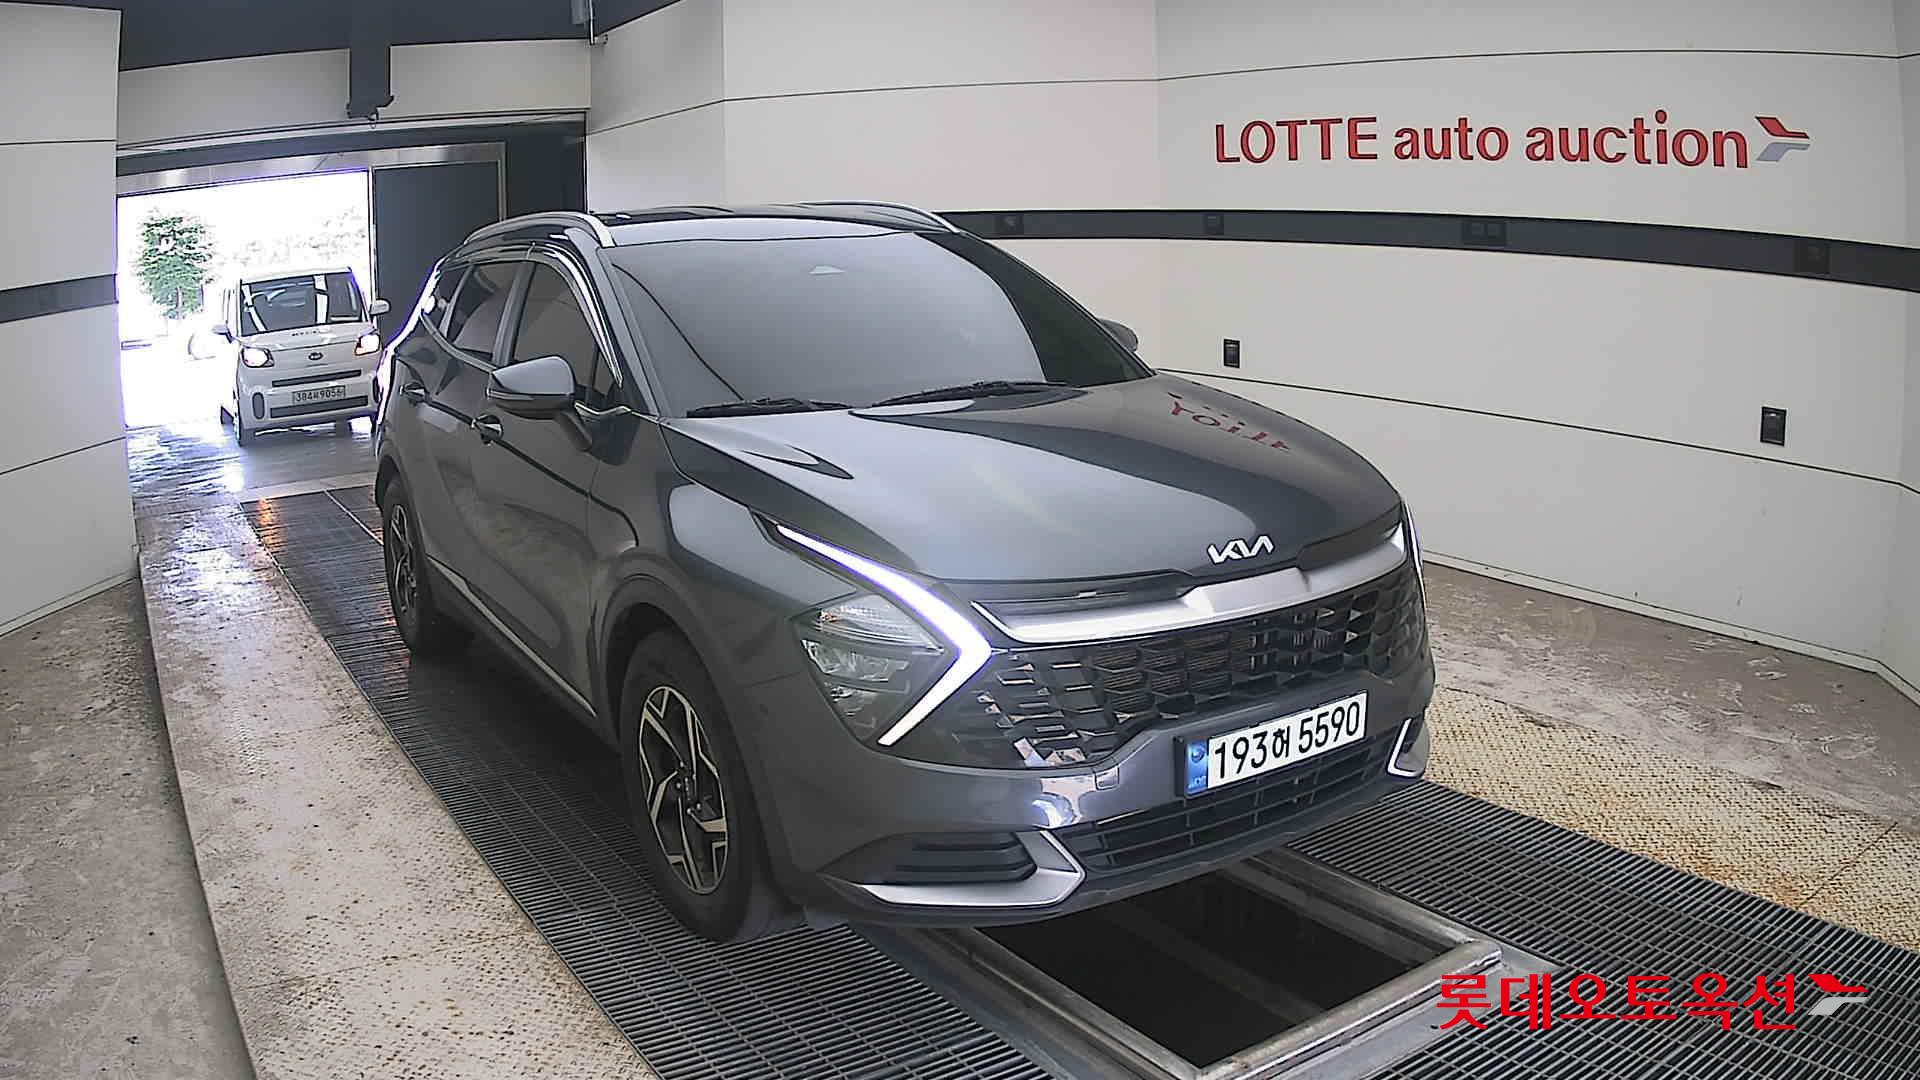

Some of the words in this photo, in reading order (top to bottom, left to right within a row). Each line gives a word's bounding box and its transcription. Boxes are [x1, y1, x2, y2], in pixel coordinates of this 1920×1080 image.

[1215, 117, 1378, 163] LOTTE
[1394, 117, 1510, 161] auto
[1526, 109, 1749, 168] auction
[1207, 535, 1274, 564] KIA
[1215, 725, 1290, 779] 193허
[1298, 701, 1360, 753] 5590
